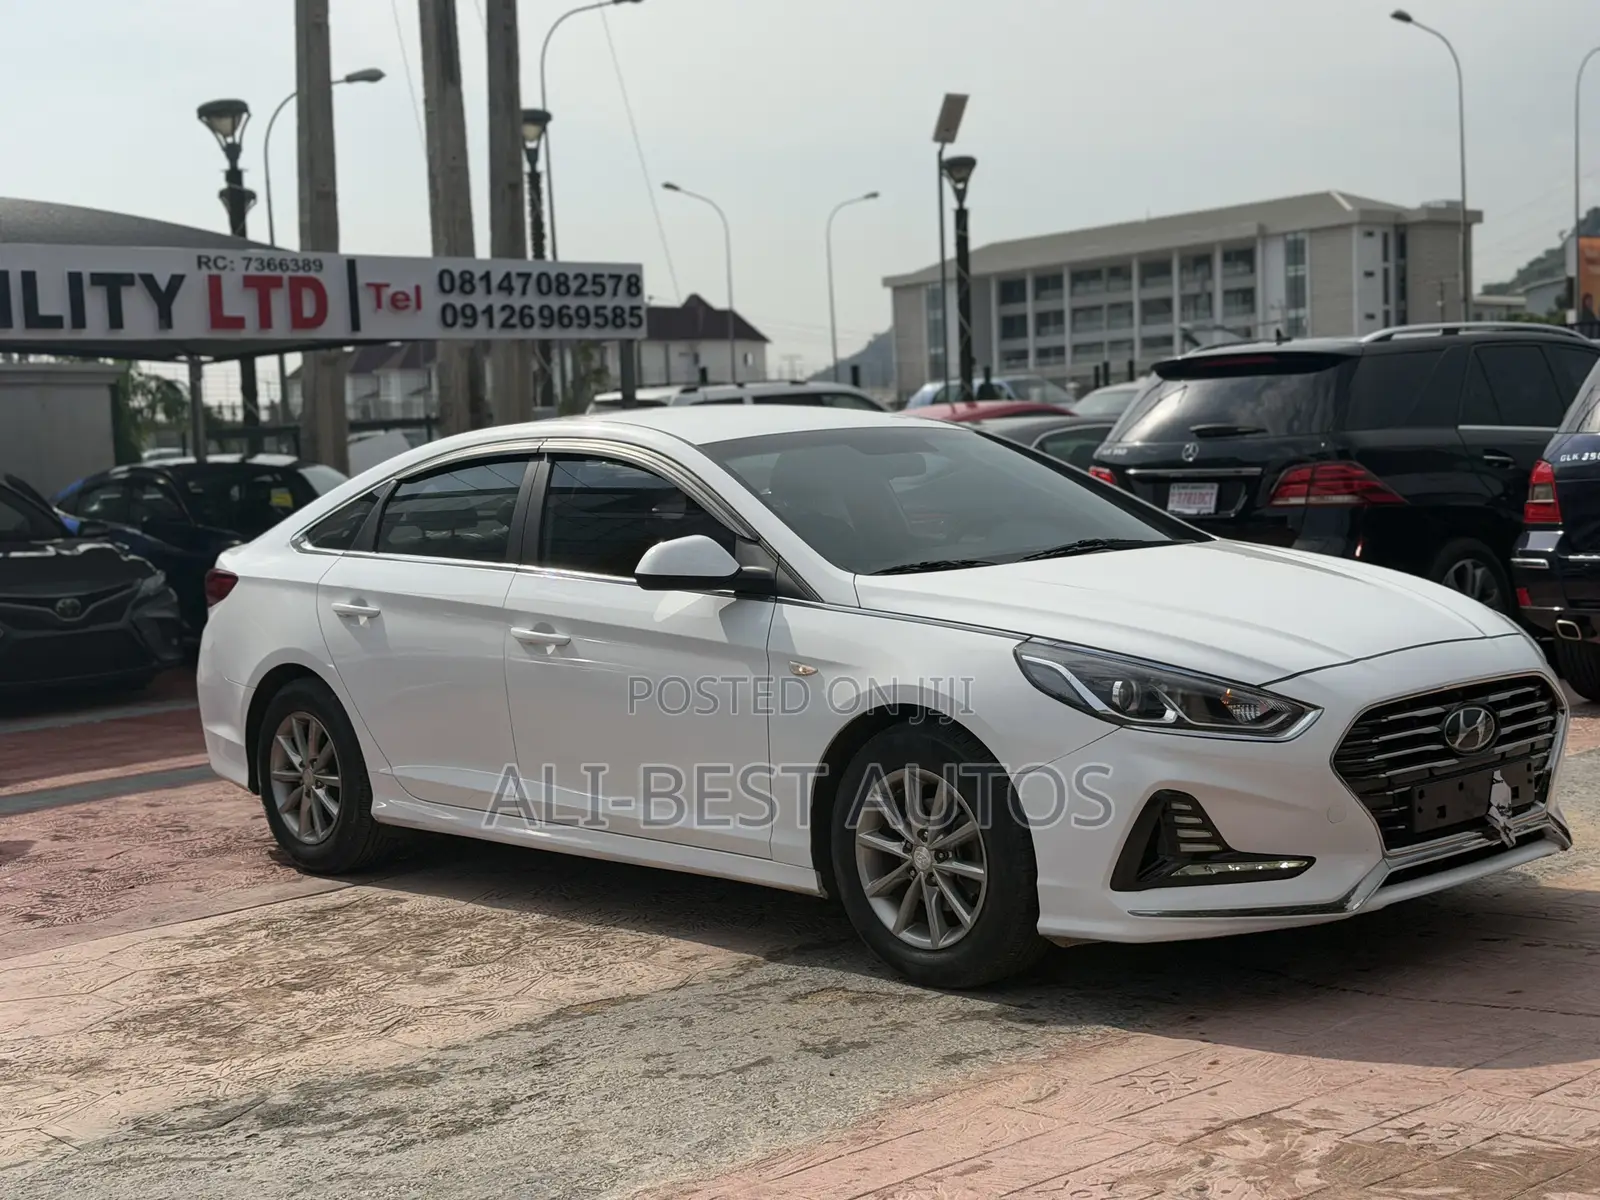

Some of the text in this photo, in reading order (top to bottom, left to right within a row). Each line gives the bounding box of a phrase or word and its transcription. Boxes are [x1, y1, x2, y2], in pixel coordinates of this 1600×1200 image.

[197, 255, 323, 272] RC: 7366389
[438, 269, 641, 297] 08147082578
[207, 274, 329, 330] LTD
[366, 283, 422, 312] Tel
[441, 303, 644, 329] 09126969585
[1560, 454, 1579, 462] GLK
